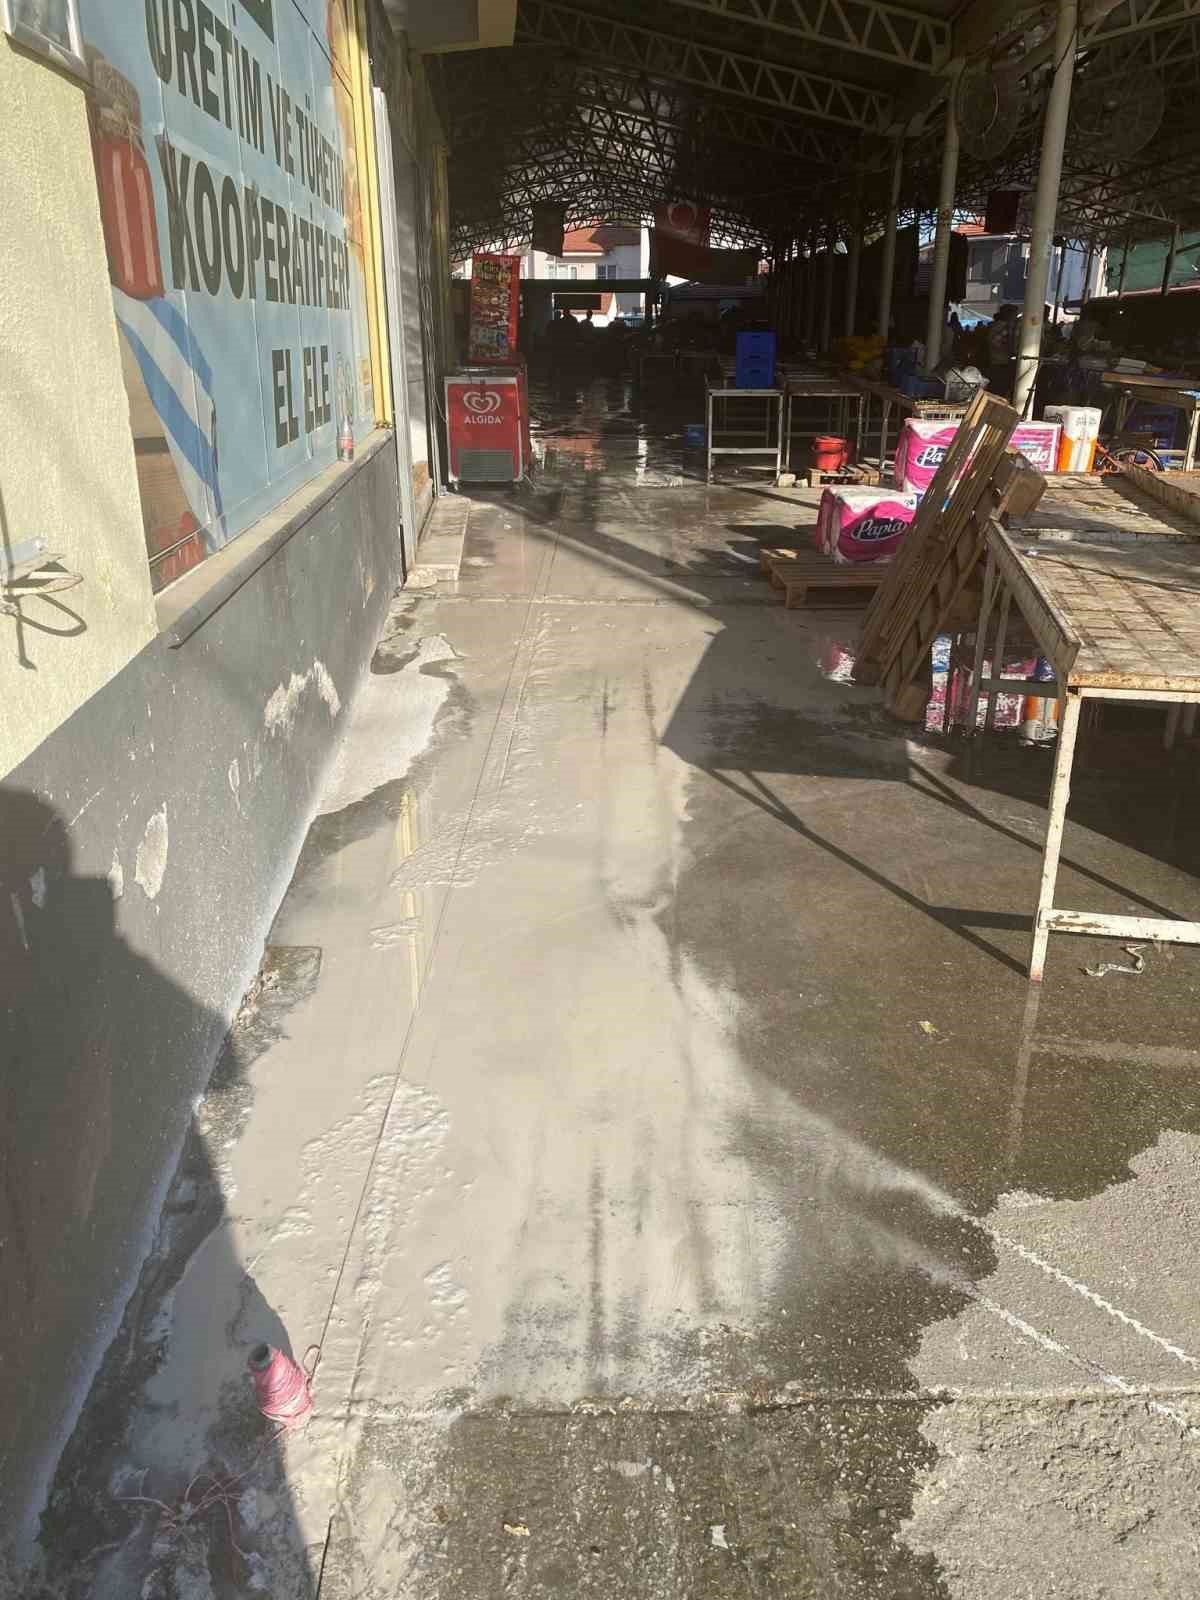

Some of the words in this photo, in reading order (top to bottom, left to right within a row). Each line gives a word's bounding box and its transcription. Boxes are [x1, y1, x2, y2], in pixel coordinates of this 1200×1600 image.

[267, 72, 294, 177] VE
[271, 348, 299, 448] EL
[303, 345, 331, 434] ELE
[464, 415, 500, 425] ALGIDA
[857, 517, 904, 539] Papia
